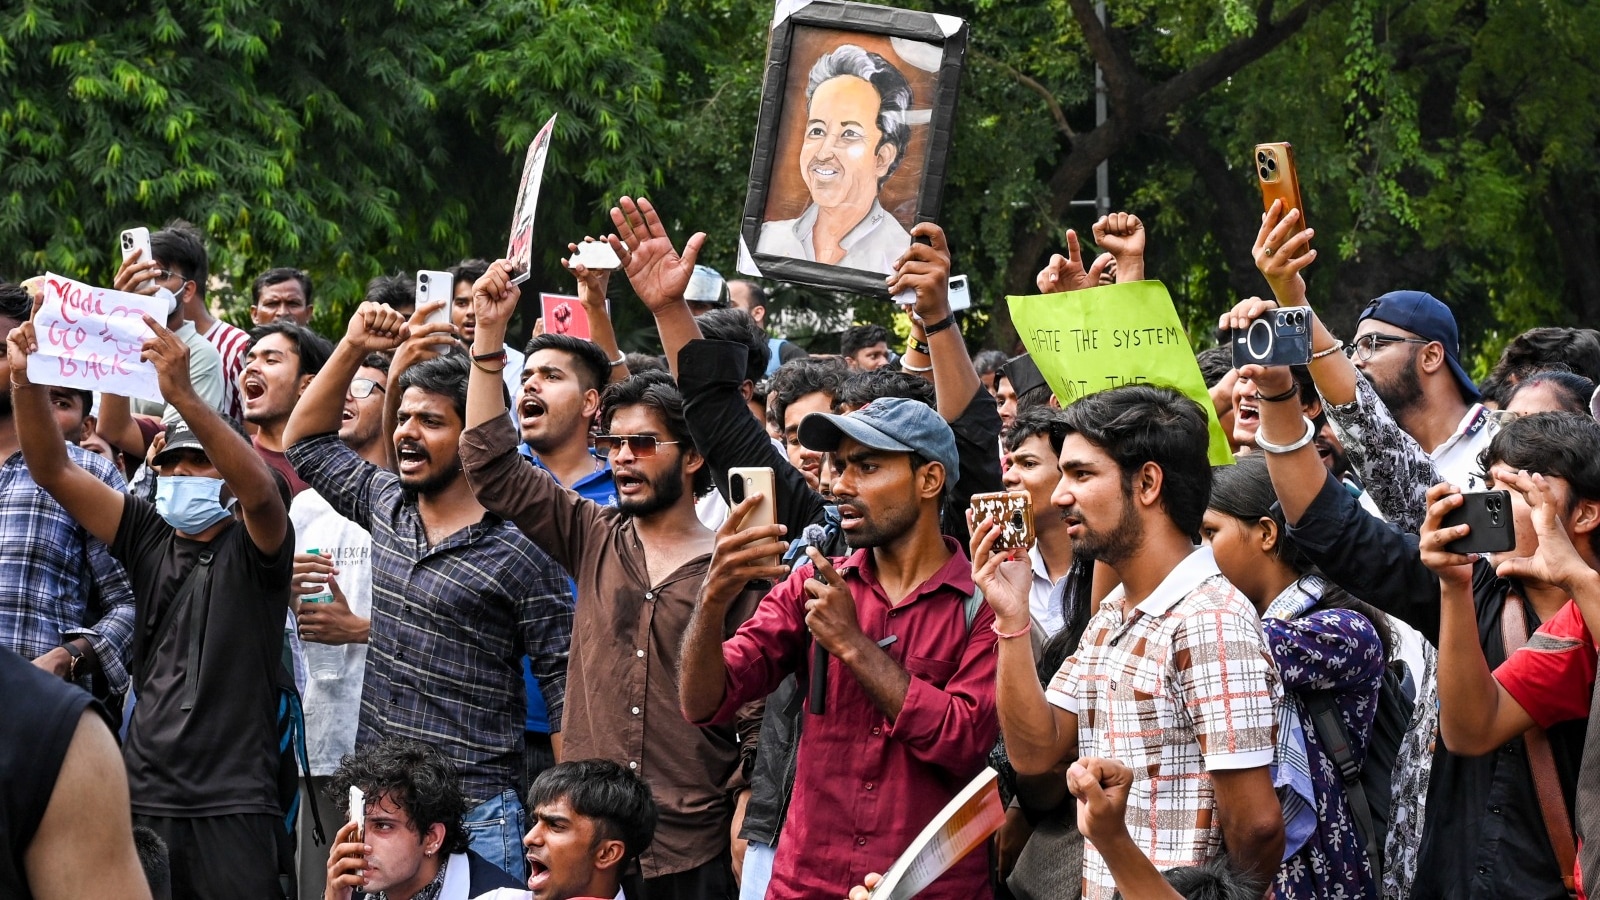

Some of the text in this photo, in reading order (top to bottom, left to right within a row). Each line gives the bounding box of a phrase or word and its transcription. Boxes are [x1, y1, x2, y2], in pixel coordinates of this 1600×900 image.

[1028, 327, 1180, 353] HATE THE SYSTEM
[57, 351, 132, 380] BACK
[1061, 376, 1088, 398] NOT
[344, 547, 372, 558] EXCH
